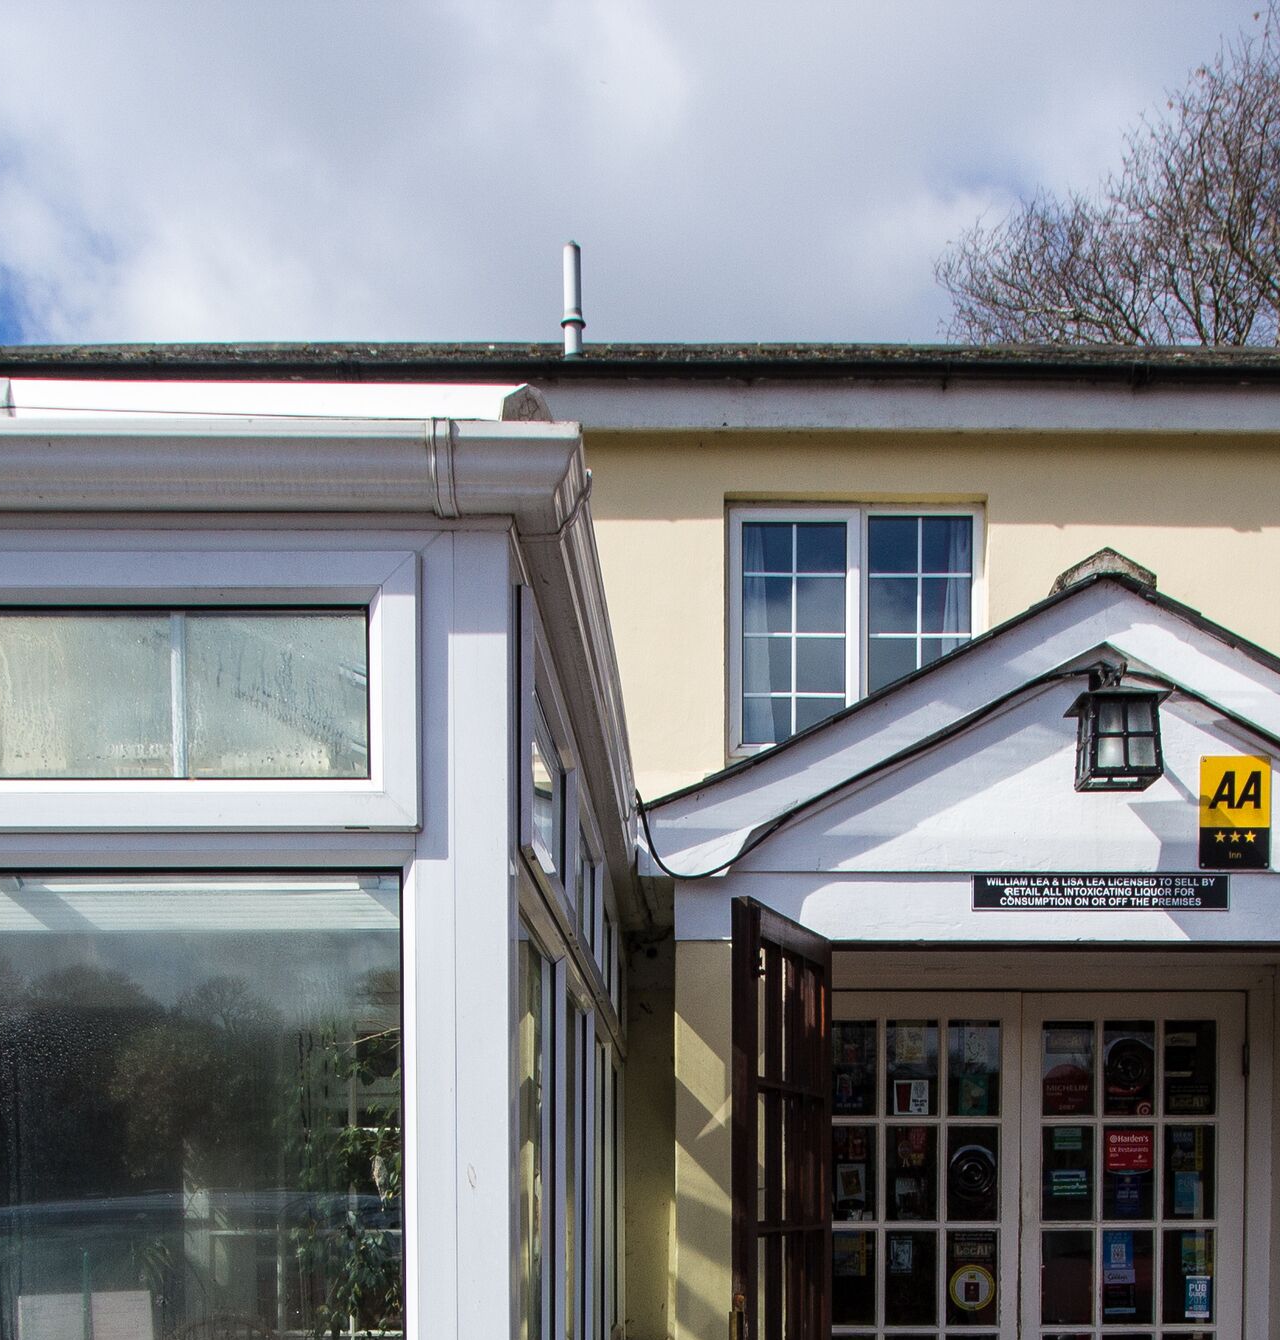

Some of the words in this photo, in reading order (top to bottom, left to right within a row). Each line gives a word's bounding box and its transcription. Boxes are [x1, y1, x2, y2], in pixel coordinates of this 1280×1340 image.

[1208, 771, 1261, 809] AA
[1228, 851, 1242, 859] Inn
[986, 878, 1028, 886] WILLIAM
[1030, 878, 1050, 886] LEA
[1052, 878, 1059, 886] &
[1062, 878, 1084, 886] LISA
[1086, 878, 1106, 886] LEA
[1108, 878, 1156, 886] LICENSED
[1160, 878, 1172, 886] TO
[1174, 878, 1200, 886] SELL
[1202, 878, 1215, 886] BY
[1006, 888, 1040, 896] RETAIL
[1043, 888, 1062, 896] ALL
[1064, 888, 1132, 896] INTOXICATING
[1134, 888, 1172, 896] LIQUOR
[1174, 888, 1194, 896] FOR
[1000, 898, 1072, 906] CONSUMPTION
[1074, 898, 1088, 906] ON
[1092, 898, 1106, 906] OR
[1108, 898, 1128, 906] OFF
[1130, 898, 1150, 906] THE
[1152, 898, 1202, 906] PREMISES
[1117, 1134, 1149, 1143] Harden's
[1188, 1283, 1207, 1292] PUB
